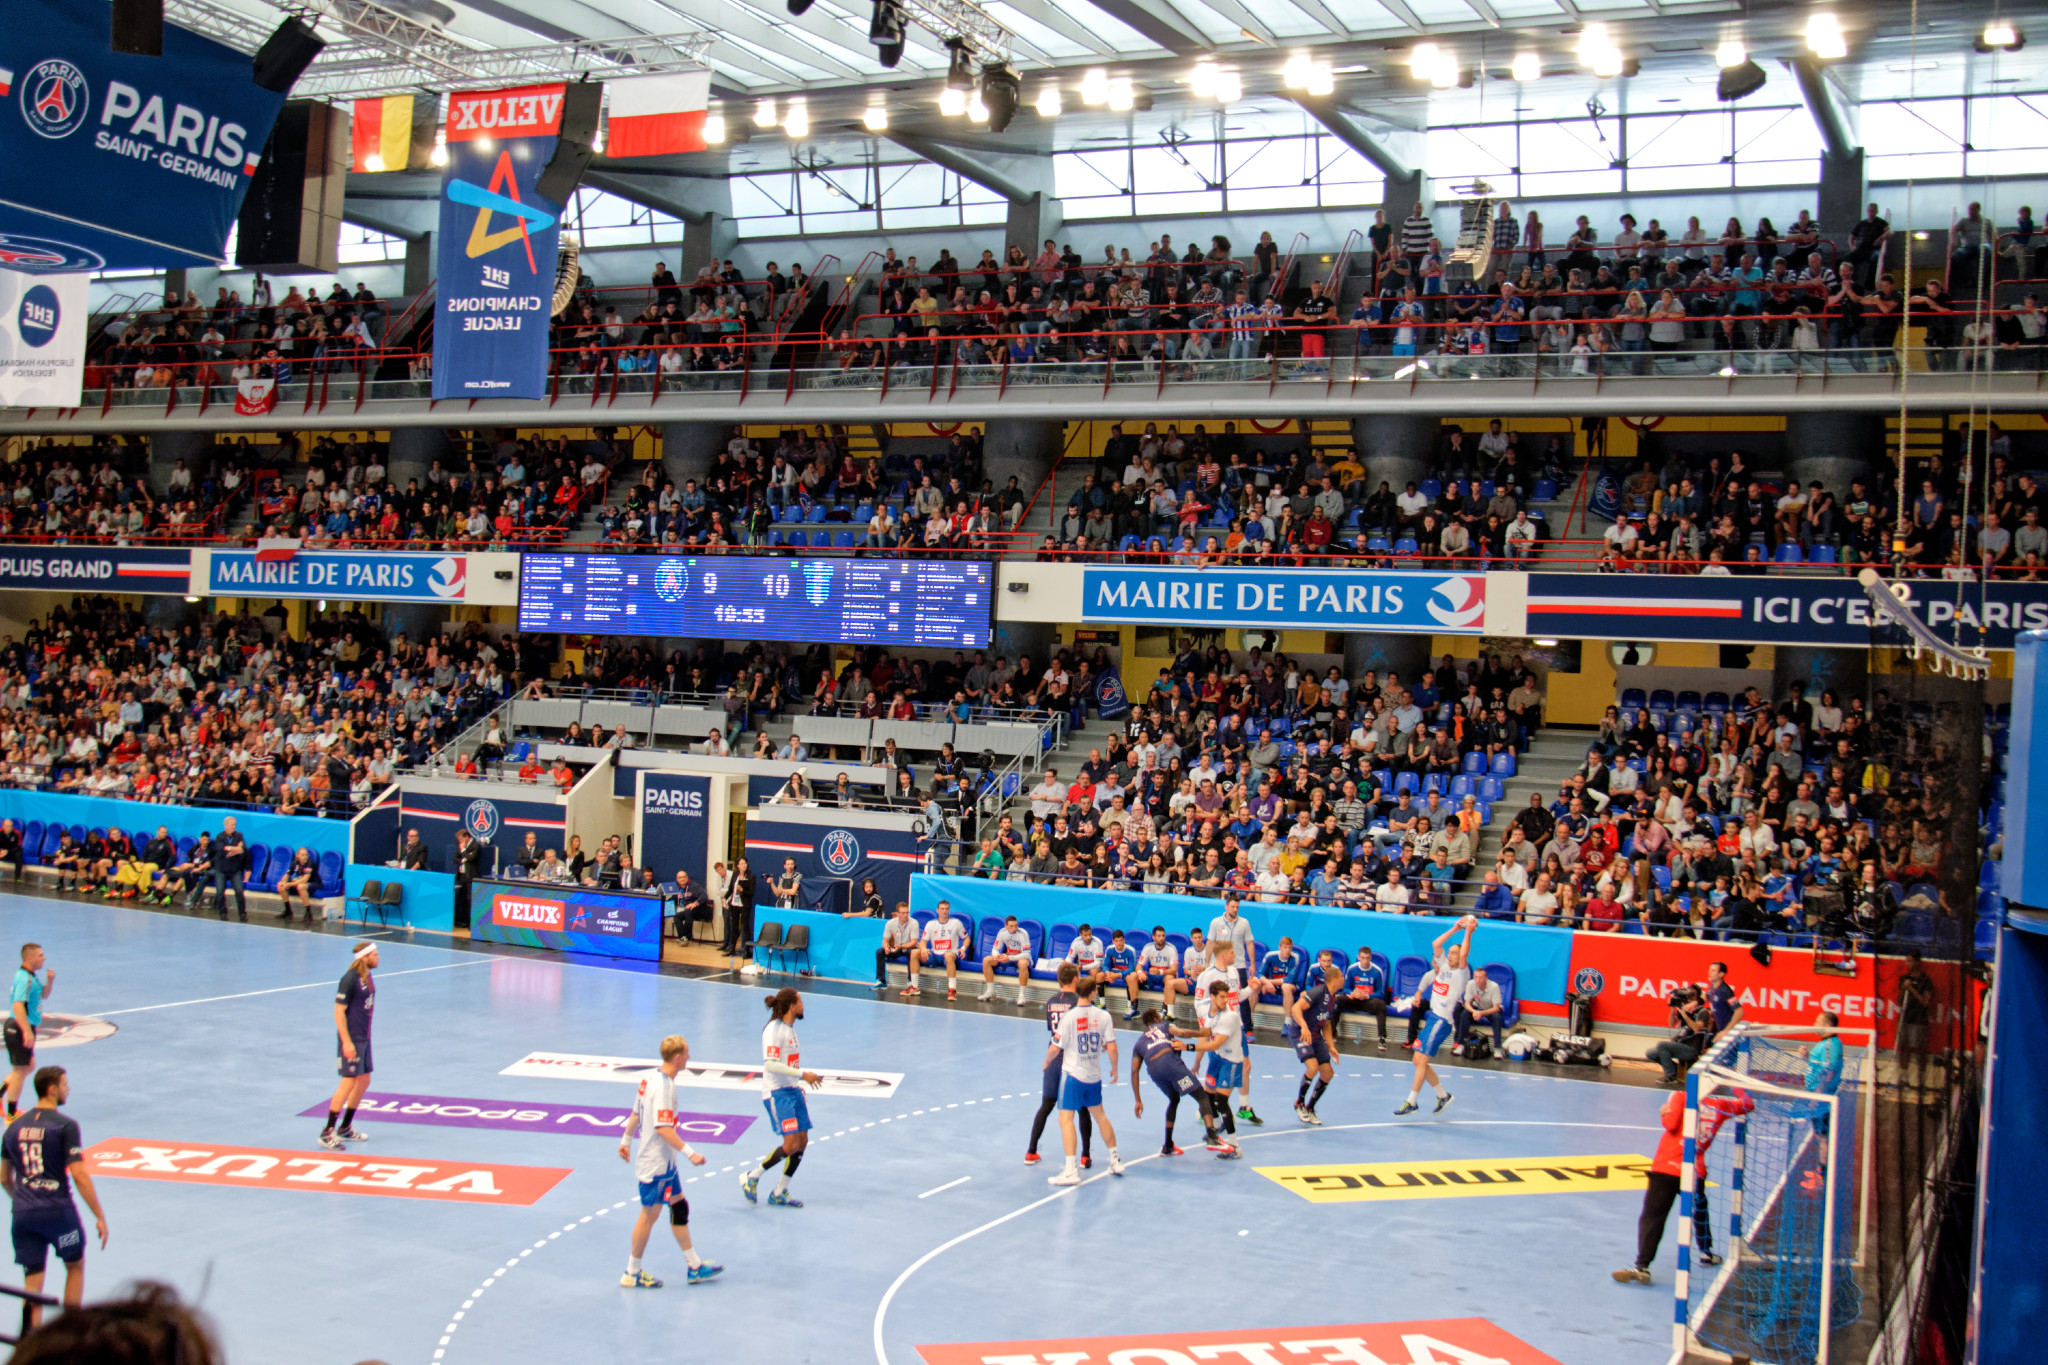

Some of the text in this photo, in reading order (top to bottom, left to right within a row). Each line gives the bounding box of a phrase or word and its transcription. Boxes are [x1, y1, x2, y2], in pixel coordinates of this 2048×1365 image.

[38, 63, 82, 89] PARIS
[101, 81, 247, 167] PARIS
[95, 131, 238, 190] SAINT-GERMAIN
[0, 558, 112, 578] PLUS GRAND
[217, 561, 414, 588] MAIRIE DE PARIS
[703, 572, 718, 594] 9
[763, 574, 790, 599] 10
[1097, 580, 1403, 615] MAIRIE DE PARIS
[1754, 597, 1800, 623] ICI
[1927, 600, 2048, 629] PARIS
[471, 801, 494, 813] PARIS
[645, 787, 703, 809] PARIS
[645, 806, 703, 818] SAINT-GERMAIN
[827, 832, 854, 845] PARIS
[597, 918, 629, 927] CHAMPIONS
[1077, 1032, 1100, 1054] 89
[1552, 1032, 1592, 1047] SELECT
